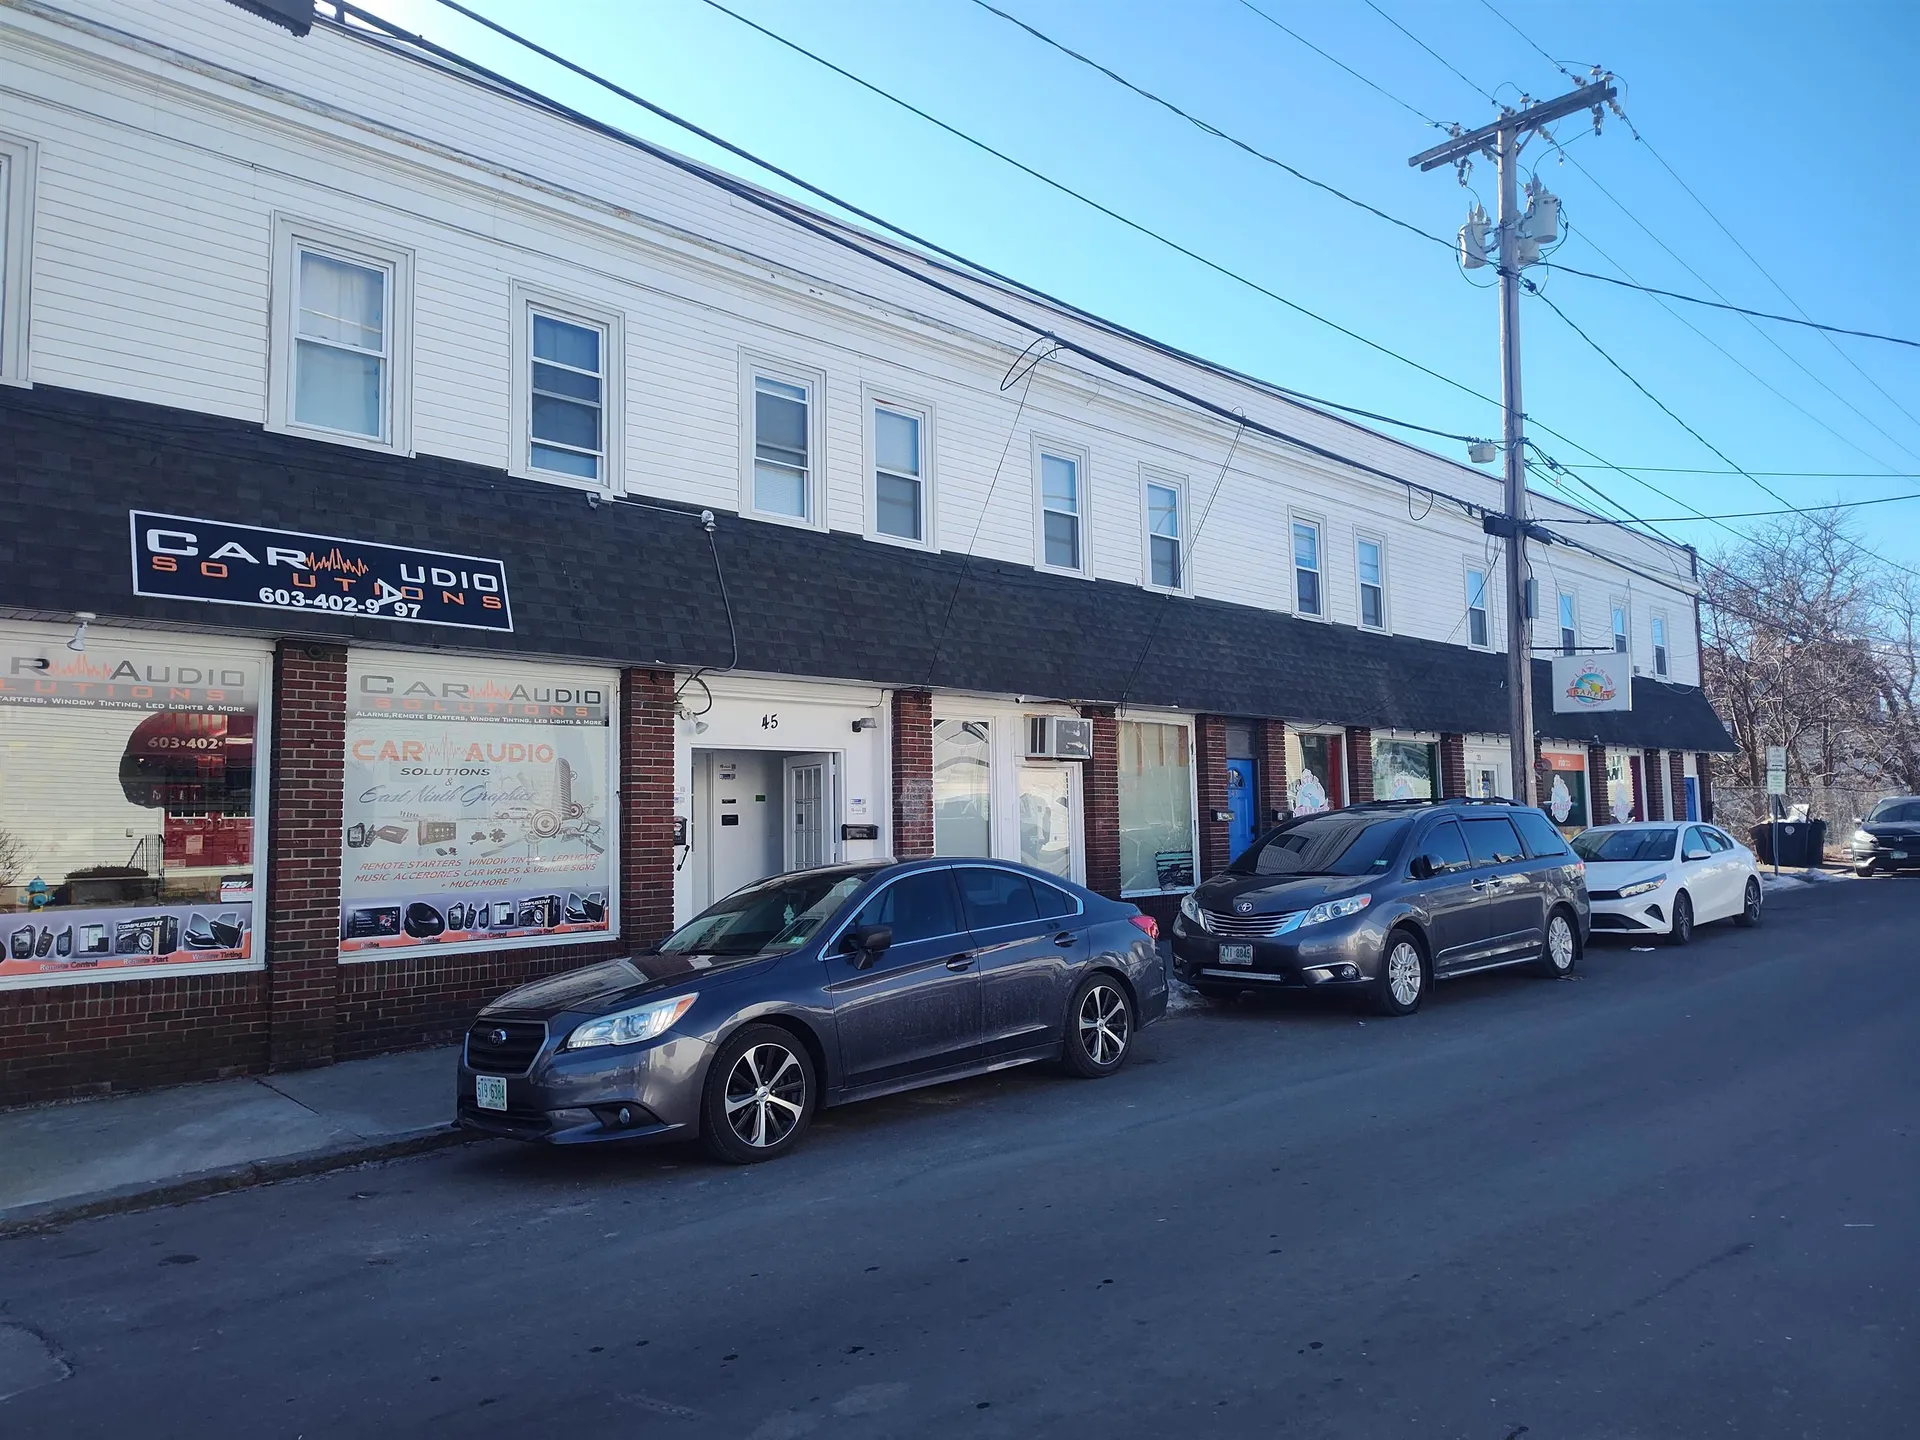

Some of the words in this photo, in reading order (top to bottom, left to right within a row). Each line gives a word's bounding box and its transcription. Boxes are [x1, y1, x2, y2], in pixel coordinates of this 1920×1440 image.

[147, 529, 309, 570] CAR
[110, 660, 244, 686] AUDIO
[360, 674, 470, 699] CAR
[509, 684, 601, 704] AUDIO
[51, 697, 95, 706] WINDOW
[168, 703, 203, 711] LIGHTS
[375, 697, 588, 716] SOLUTIONS
[761, 714, 779, 730] 45
[352, 739, 424, 762] CAR
[465, 742, 554, 763] AUDIO
[400, 767, 490, 776] SOLUTIONS
[444, 777, 452, 787] &
[359, 784, 411, 804] East
[354, 873, 390, 882] MUSIC
[463, 869, 484, 877] CAR
[486, 867, 520, 876] WRAPS
[533, 864, 570, 873] VEHICLE
[570, 863, 597, 872] SIGNS
[360, 861, 406, 871] REMOTE
[407, 859, 463, 869] STARTERS
[468, 857, 509, 866] WINDOW
[449, 880, 478, 889] MUCH
[479, 878, 508, 887] MORE
[70, 960, 98, 969] Control
